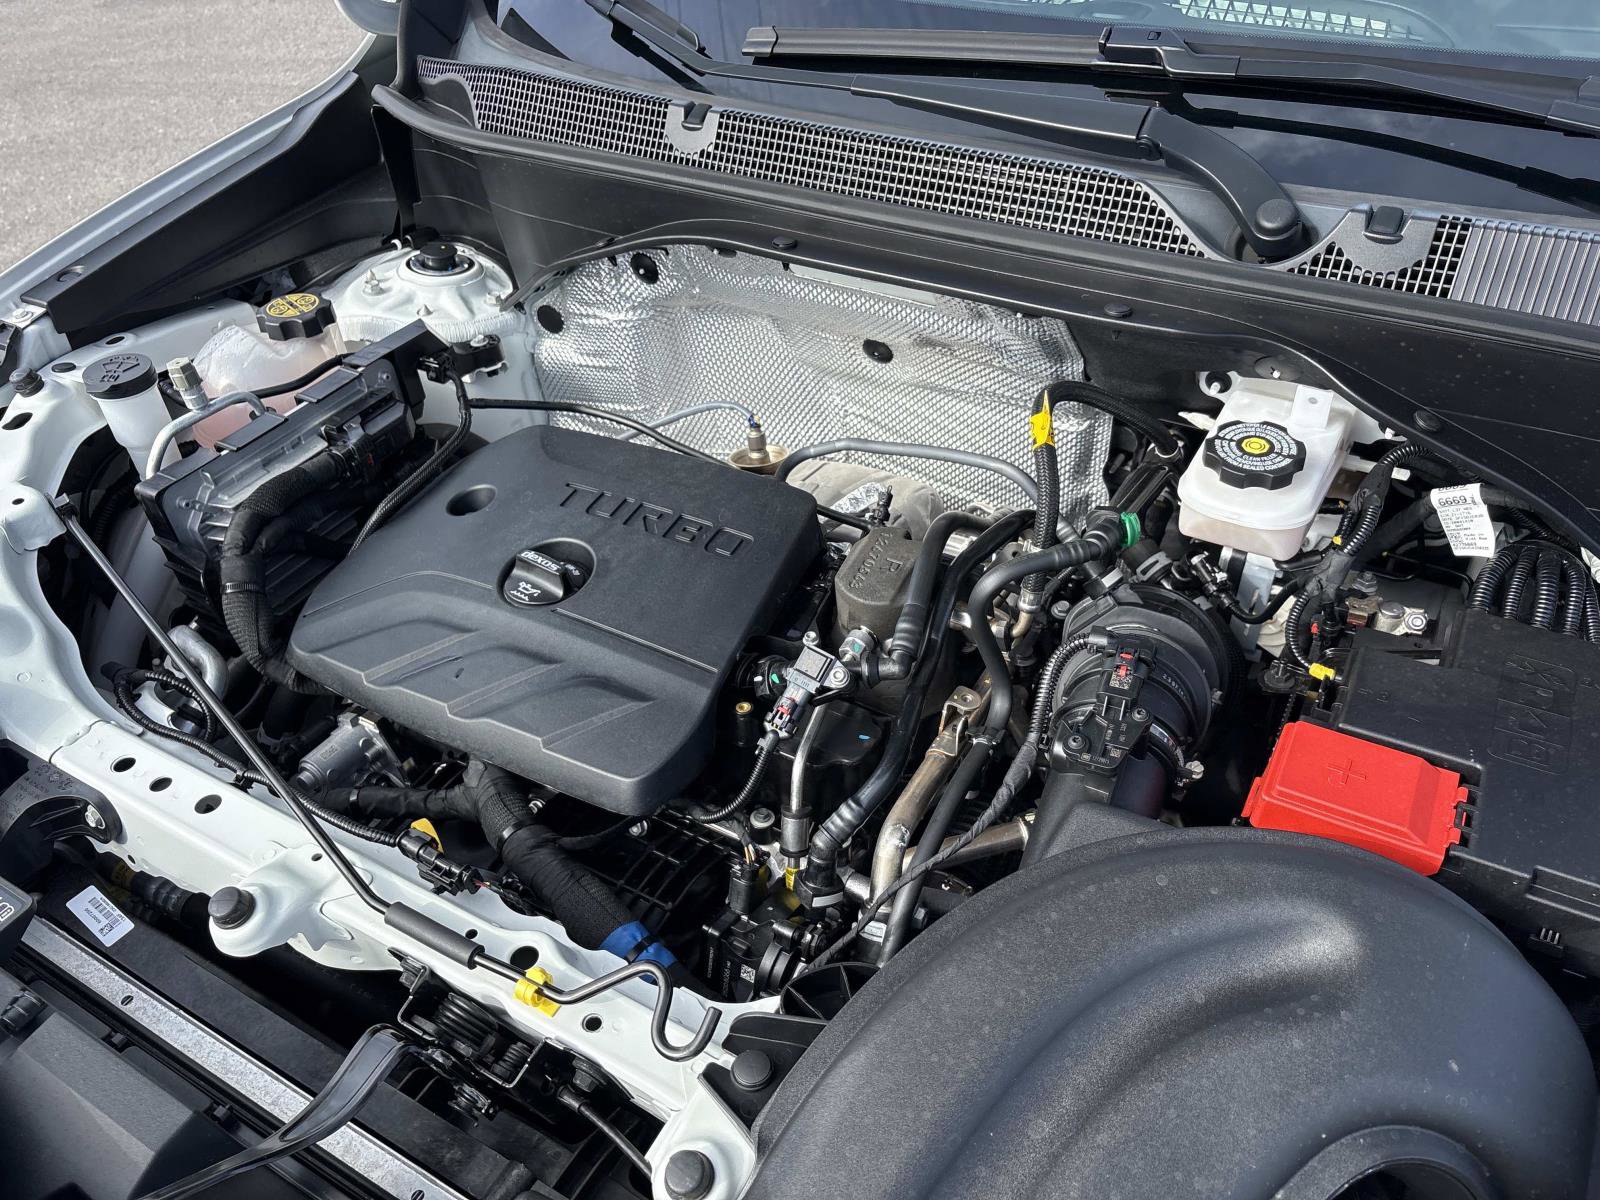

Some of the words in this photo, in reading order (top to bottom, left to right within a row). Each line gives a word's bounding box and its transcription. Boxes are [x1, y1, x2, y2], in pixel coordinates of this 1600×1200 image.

[1438, 495, 1467, 506] 6669
[559, 482, 755, 557] TURBO
[520, 549, 562, 573] dexos
